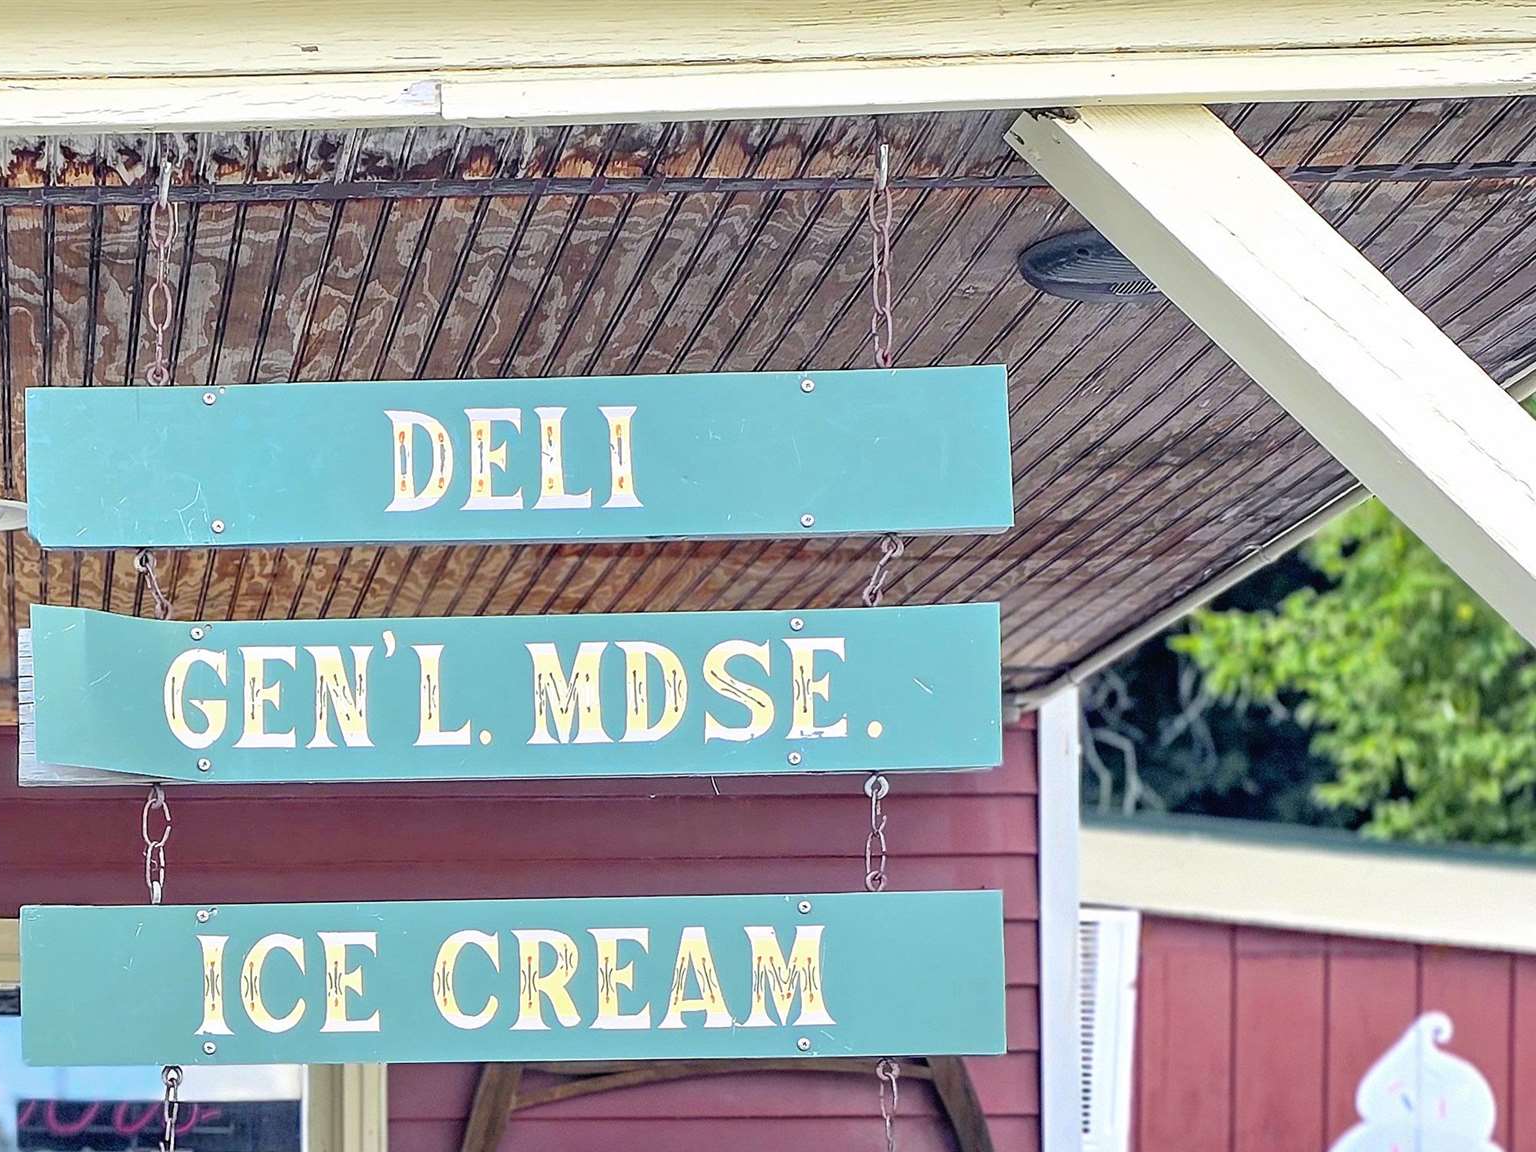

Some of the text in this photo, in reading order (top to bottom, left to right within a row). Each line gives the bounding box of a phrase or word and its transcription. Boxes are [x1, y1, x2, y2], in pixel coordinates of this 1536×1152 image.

[384, 405, 644, 515] DELI
[162, 630, 883, 750] GEN'L. MDSE.
[194, 924, 837, 1036] ICE CREAM
